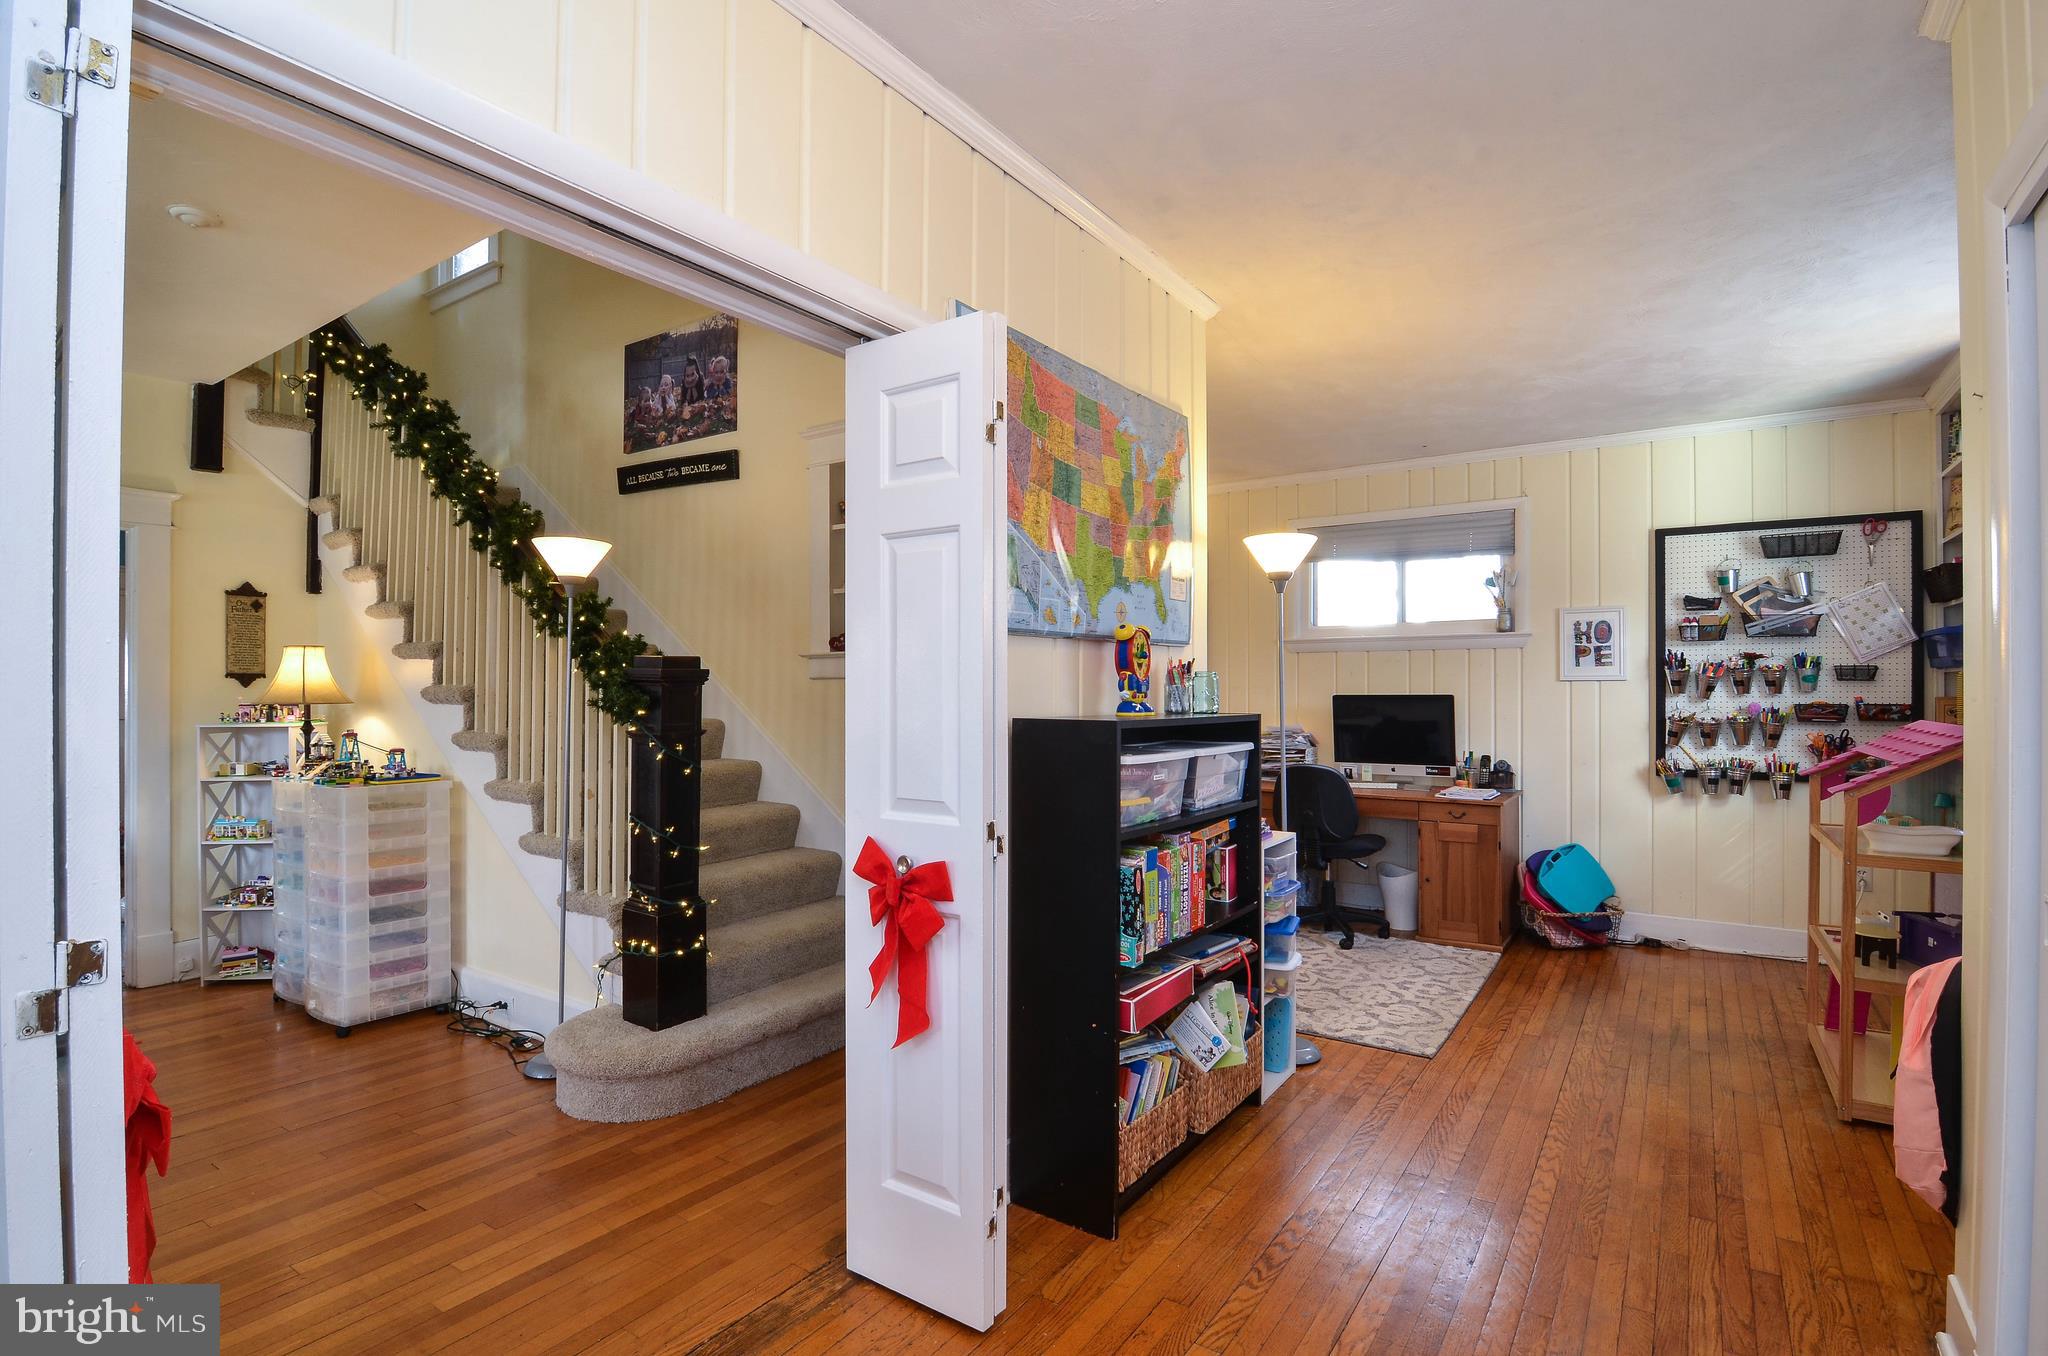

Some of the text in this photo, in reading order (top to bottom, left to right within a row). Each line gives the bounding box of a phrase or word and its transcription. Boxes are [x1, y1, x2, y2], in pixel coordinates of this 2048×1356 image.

[626, 476, 638, 486] ALL
[638, 470, 664, 483] BECAUSE
[681, 463, 710, 475] BECAME
[711, 463, 728, 472] one
